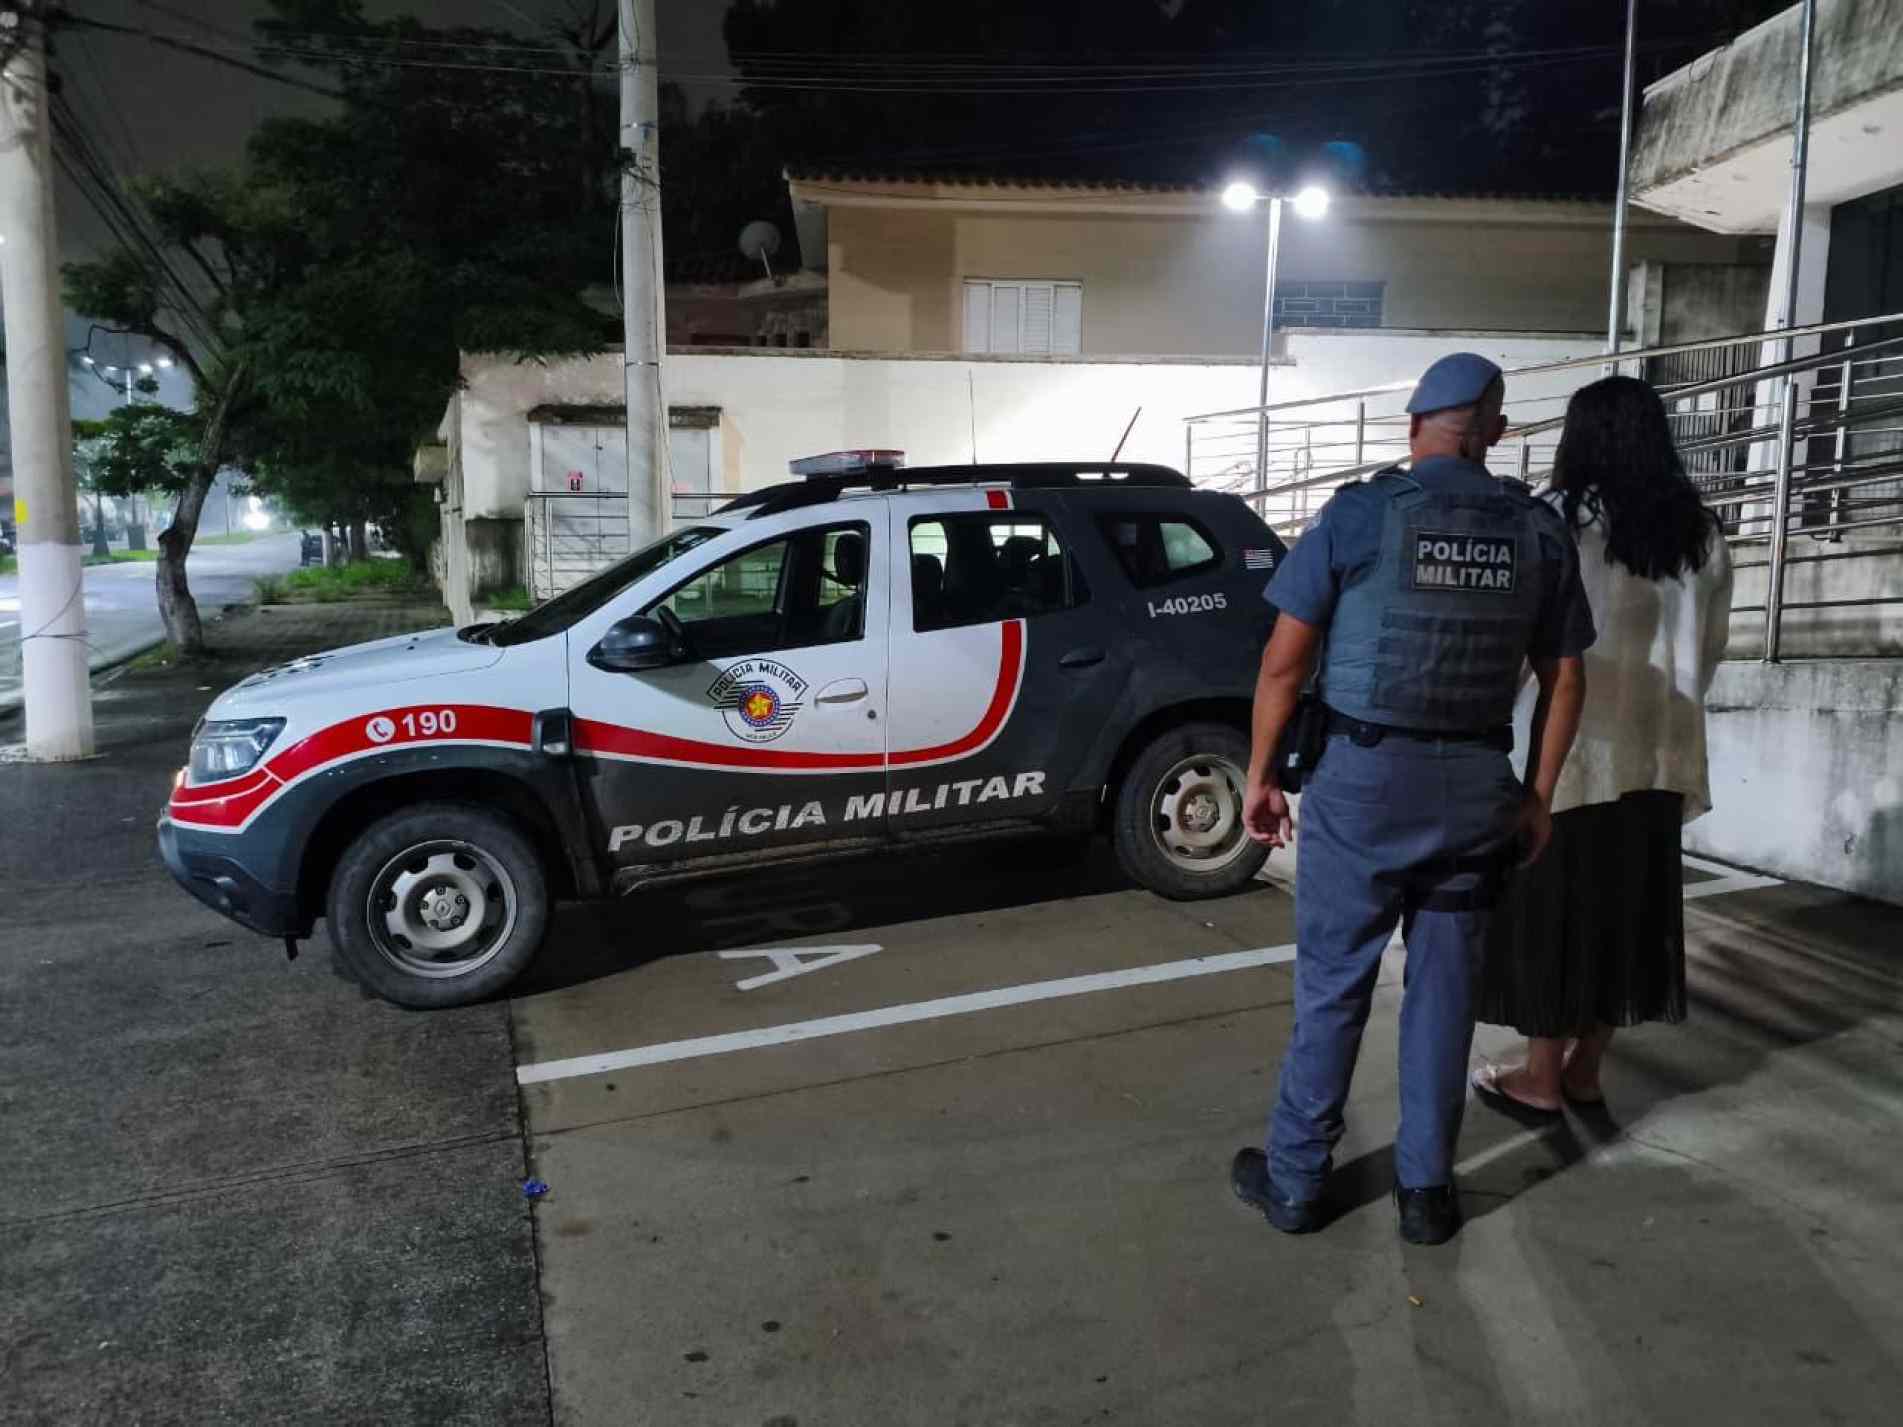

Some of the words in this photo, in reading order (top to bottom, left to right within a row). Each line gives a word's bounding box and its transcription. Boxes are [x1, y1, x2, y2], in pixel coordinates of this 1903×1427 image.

[1418, 538, 1511, 564] POLÍCIA
[1416, 564, 1510, 588] MILITAR
[1147, 592, 1227, 618] I-40205
[759, 662, 802, 693] MILITAR
[402, 710, 457, 737] 190
[608, 800, 826, 852] POLÍCIA
[843, 771, 1047, 821] MILITAR
